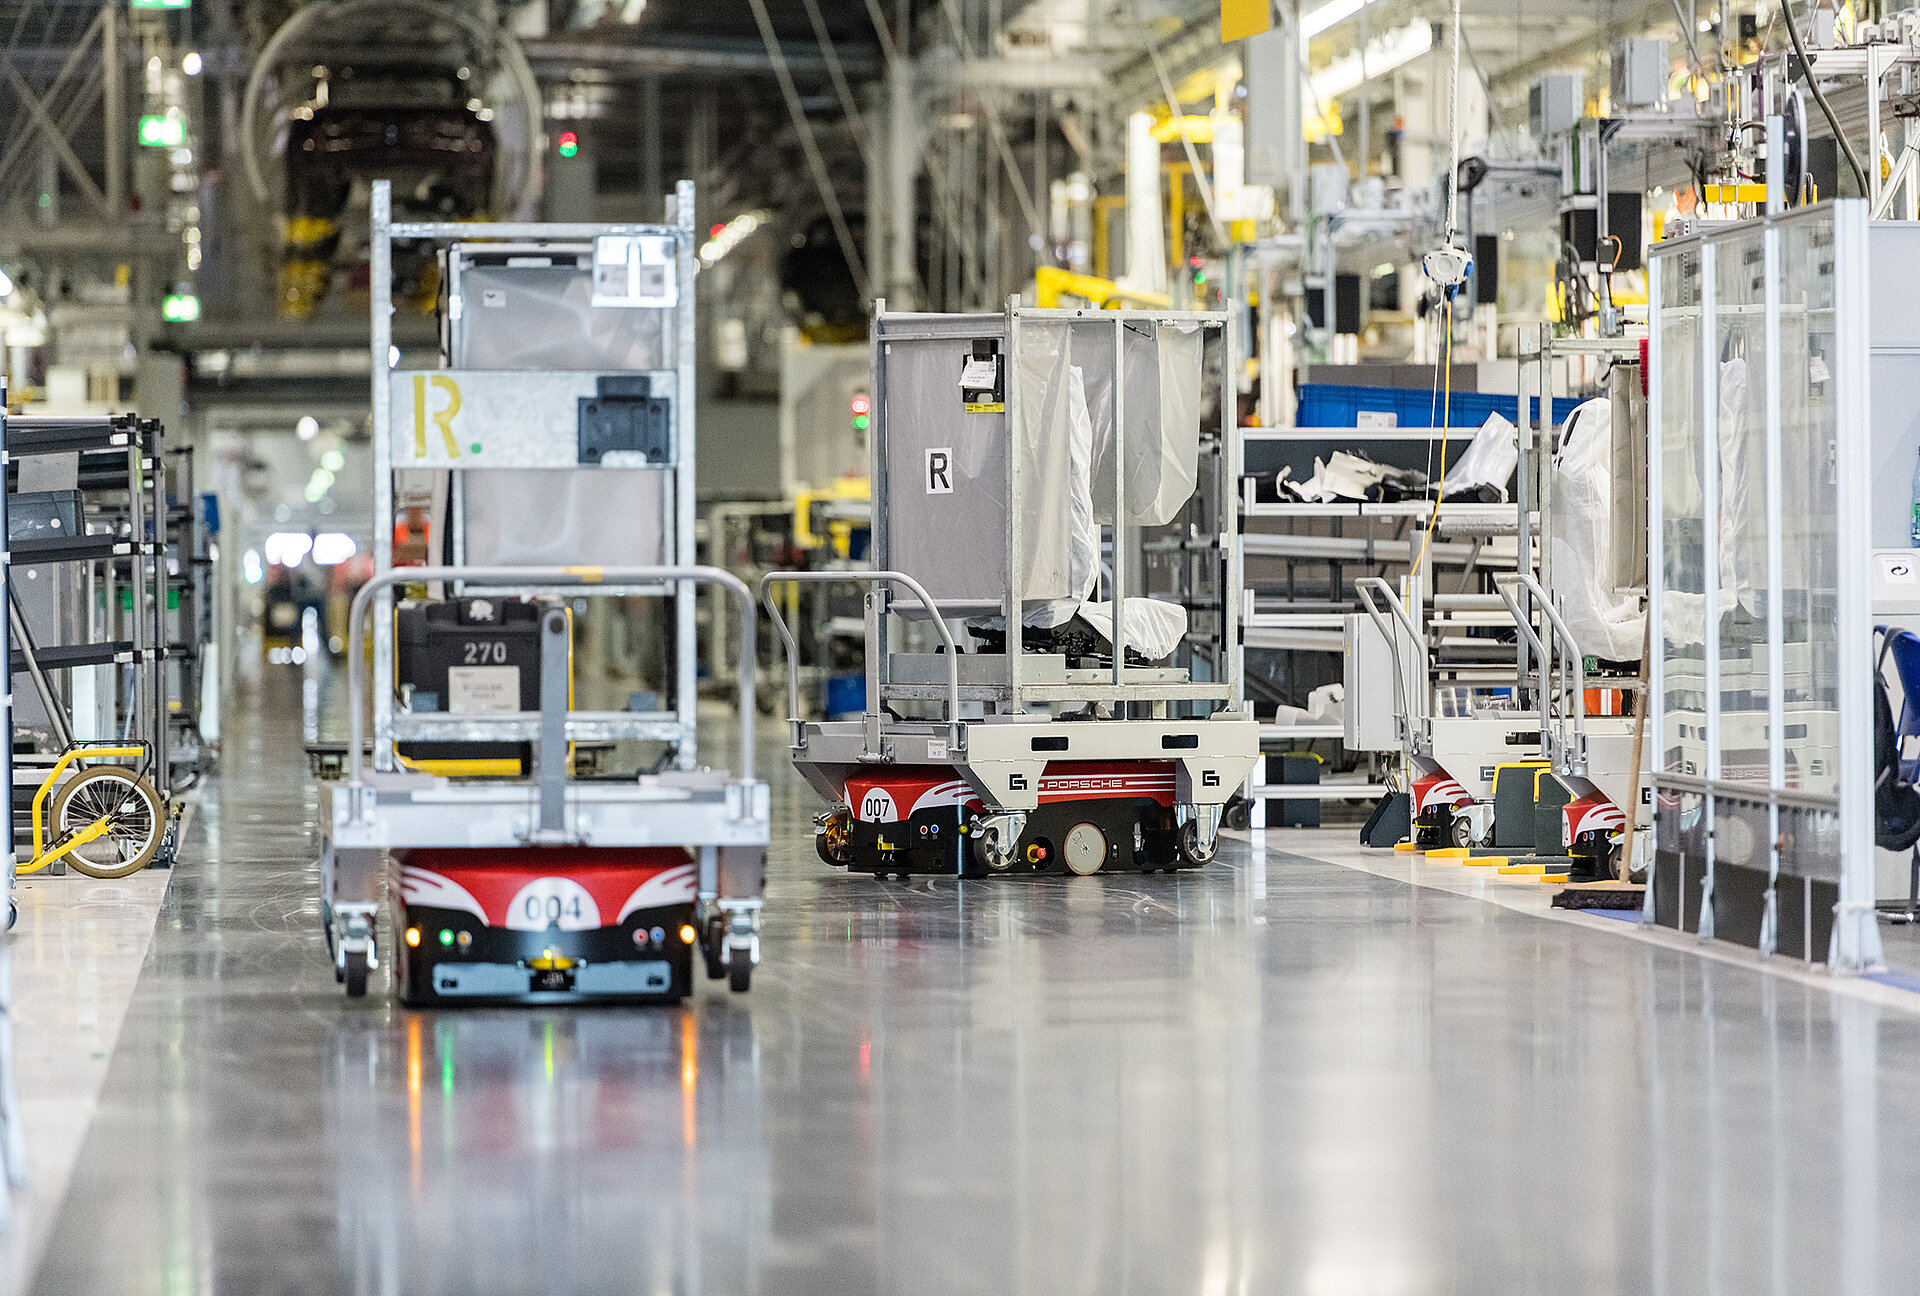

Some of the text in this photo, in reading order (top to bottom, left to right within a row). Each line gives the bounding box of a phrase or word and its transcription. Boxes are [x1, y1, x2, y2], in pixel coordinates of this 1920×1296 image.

[930, 452, 950, 490] R
[463, 641, 508, 664] 270
[1047, 779, 1123, 789] PORSCHE
[865, 798, 890, 817] 007
[524, 894, 582, 921] 004
